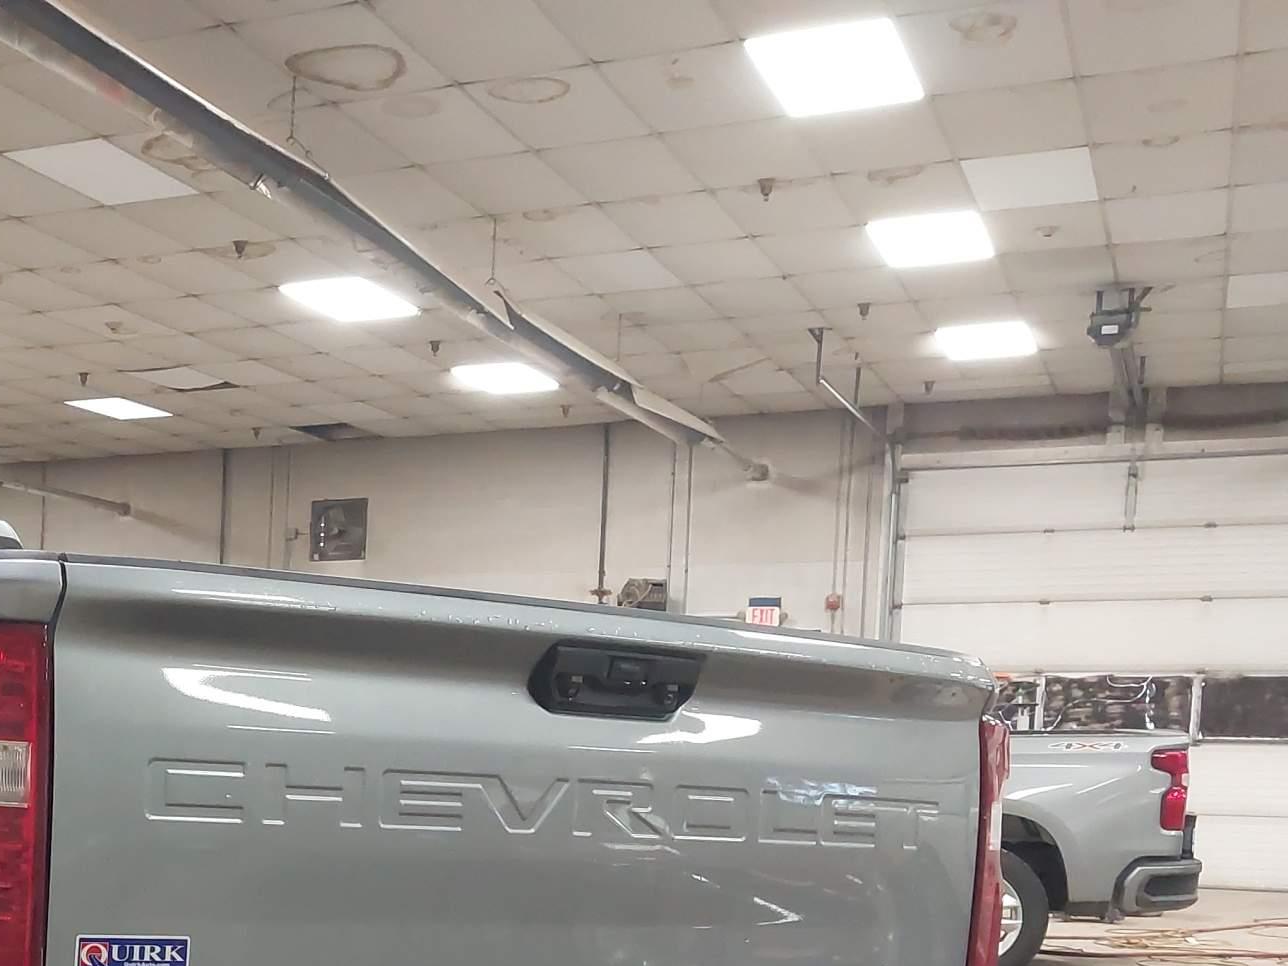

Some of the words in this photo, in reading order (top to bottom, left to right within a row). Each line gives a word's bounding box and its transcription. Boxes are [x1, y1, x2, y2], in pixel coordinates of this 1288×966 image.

[752, 608, 776, 625] EXIT
[145, 757, 940, 849] CHEVROLET
[80, 943, 185, 966] QUIRK
